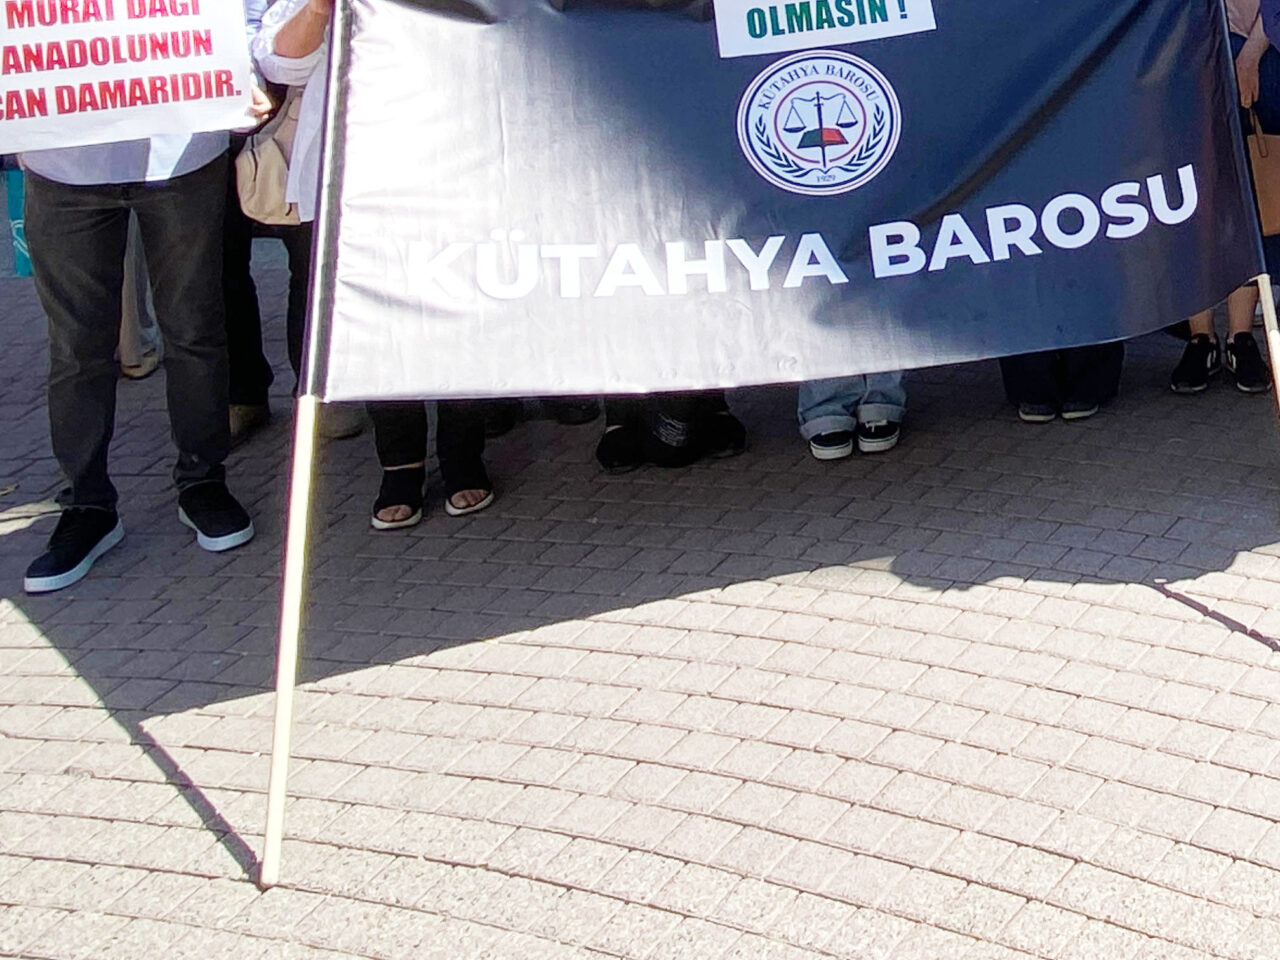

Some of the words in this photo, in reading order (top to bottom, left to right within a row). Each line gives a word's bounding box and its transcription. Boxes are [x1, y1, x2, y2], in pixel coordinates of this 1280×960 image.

[1, 29, 214, 76] ANADOLUNUN
[0, 87, 48, 120] AN
[55, 69, 242, 116] DAMARIDIR.
[757, 64, 820, 111] KÜTAHYA
[825, 64, 880, 102] BAROSU
[408, 228, 849, 300] KÜTAHYA
[868, 163, 1198, 279] BAROSU
